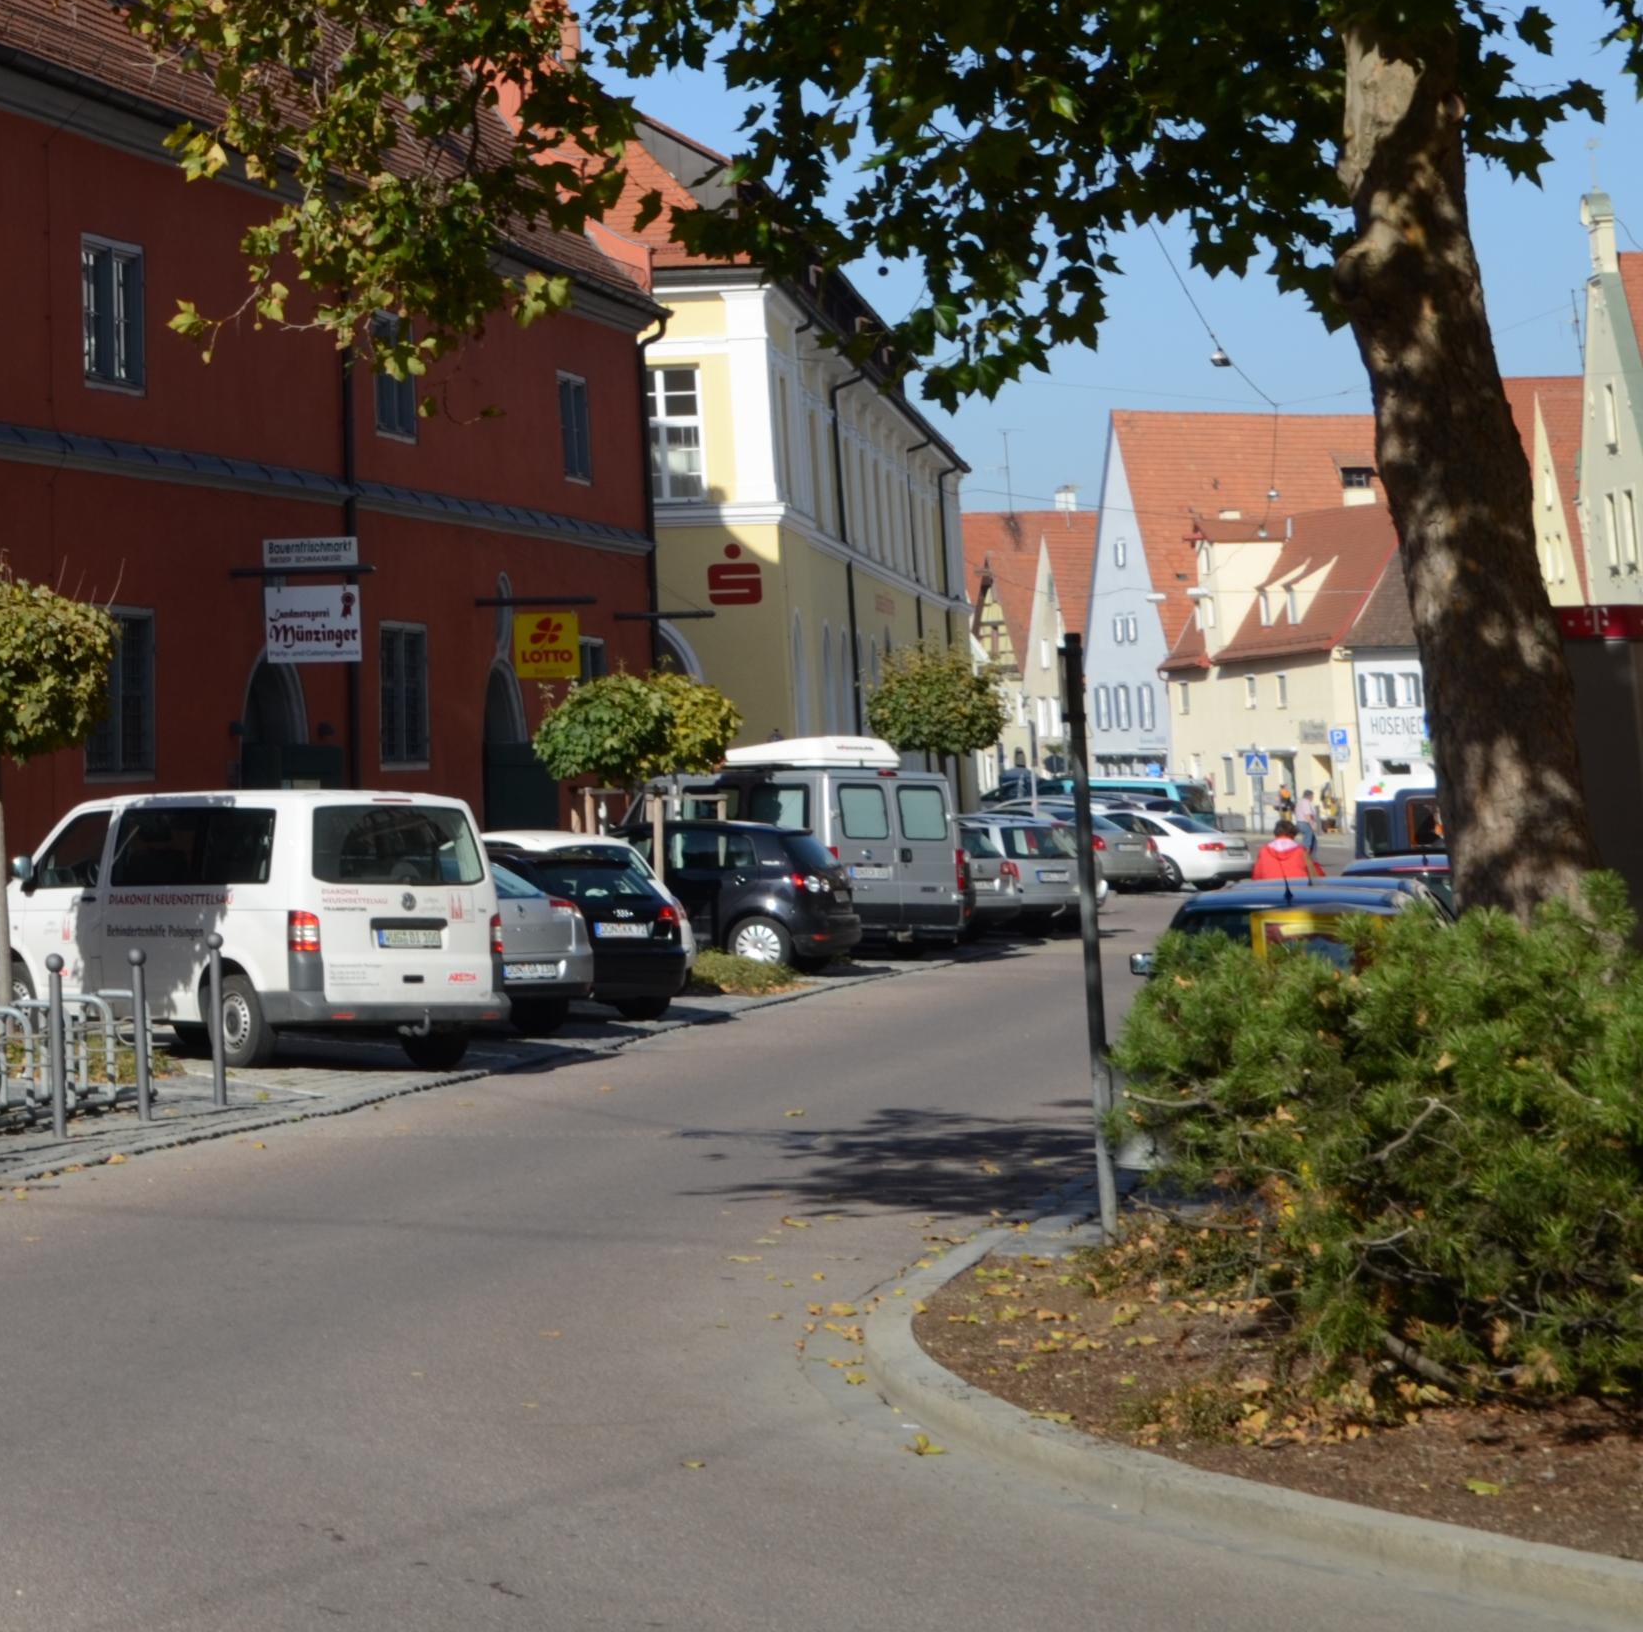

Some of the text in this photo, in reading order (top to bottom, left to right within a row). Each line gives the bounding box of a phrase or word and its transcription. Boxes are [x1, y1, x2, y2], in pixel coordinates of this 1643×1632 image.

[268, 540, 352, 555] Bauernfrischmarkt
[268, 623, 358, 648] Münzinger
[521, 650, 573, 663] LOTTO
[109, 894, 233, 906] DIAKONIE NEUENDETTELSAU
[107, 924, 204, 940] Behindertenhilfe Polsingen
